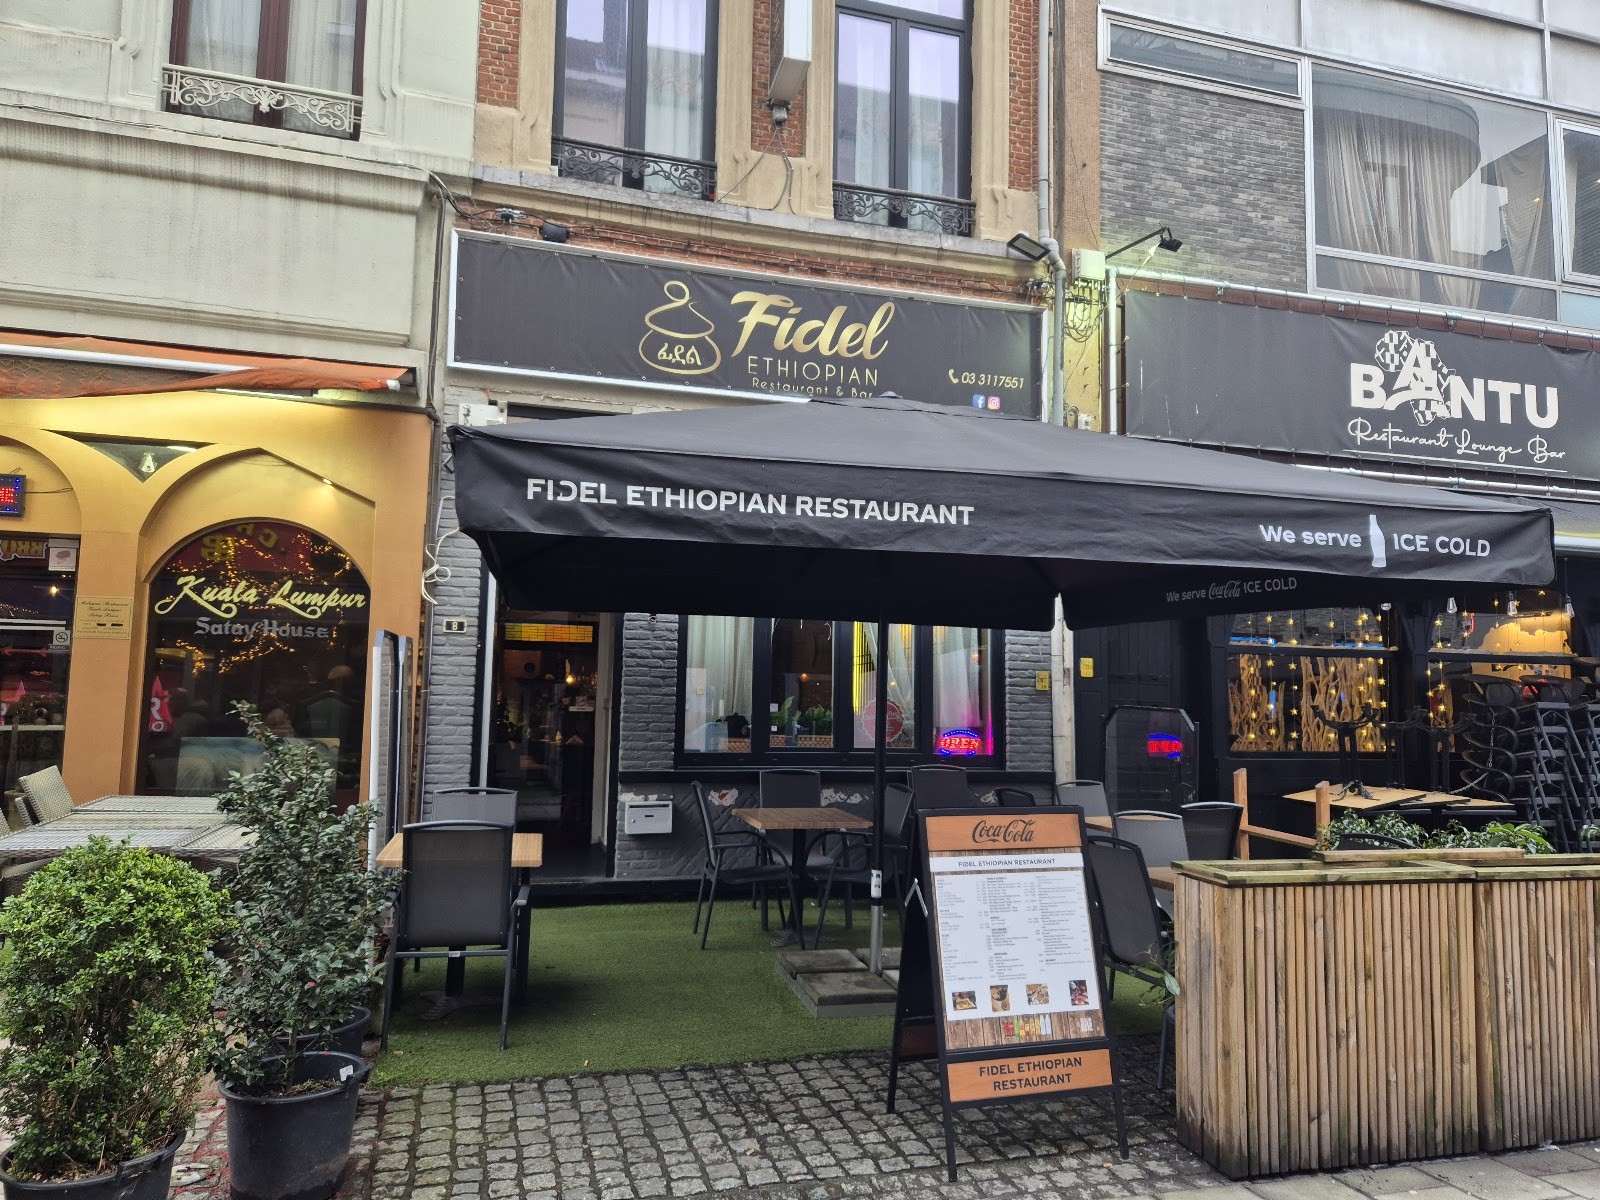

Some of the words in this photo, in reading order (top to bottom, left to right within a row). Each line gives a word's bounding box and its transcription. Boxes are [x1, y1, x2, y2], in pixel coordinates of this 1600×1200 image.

[729, 290, 896, 361] Fidel
[657, 342, 702, 366] ፊደል
[747, 354, 879, 388] ETHIOPIAN
[960, 371, 977, 385] 03
[978, 372, 1025, 389] 3117551
[751, 376, 829, 395] Restaurant
[835, 385, 844, 397] &
[851, 387, 873, 398] Bar
[1349, 338, 1559, 429] BANTU
[1347, 416, 1455, 450] Restaurant
[1454, 428, 1523, 464] Lounge
[1527, 434, 1567, 464] Bar
[526, 478, 618, 505] FIDEL
[626, 485, 788, 515] ETHIOPIAN
[795, 494, 976, 526] RESTAURANT
[1259, 524, 1297, 544] We
[1303, 530, 1363, 548] serve
[1393, 533, 1430, 552] ICE
[1435, 536, 1491, 557] COLD
[154, 575, 261, 619] Kuala
[267, 579, 367, 619] Lumpur
[1166, 591, 1180, 603] We
[1181, 588, 1207, 601] serve
[1243, 580, 1262, 594] ICE
[1264, 577, 1298, 592] COLD
[194, 616, 260, 642] Satay
[262, 618, 330, 639] House
[452, 621, 458, 631] 8
[940, 736, 981, 750] OPEN
[971, 819, 1037, 844] Coca-Cola
[958, 860, 978, 868] FIDEL
[978, 859, 1013, 868] ETHIOPIAN
[1014, 858, 1056, 866] RESTAURANT
[978, 1063, 1015, 1078] FIDEL
[1017, 1056, 1083, 1073] ETHIOPIAN
[993, 1072, 1073, 1091] RESTAURANT
